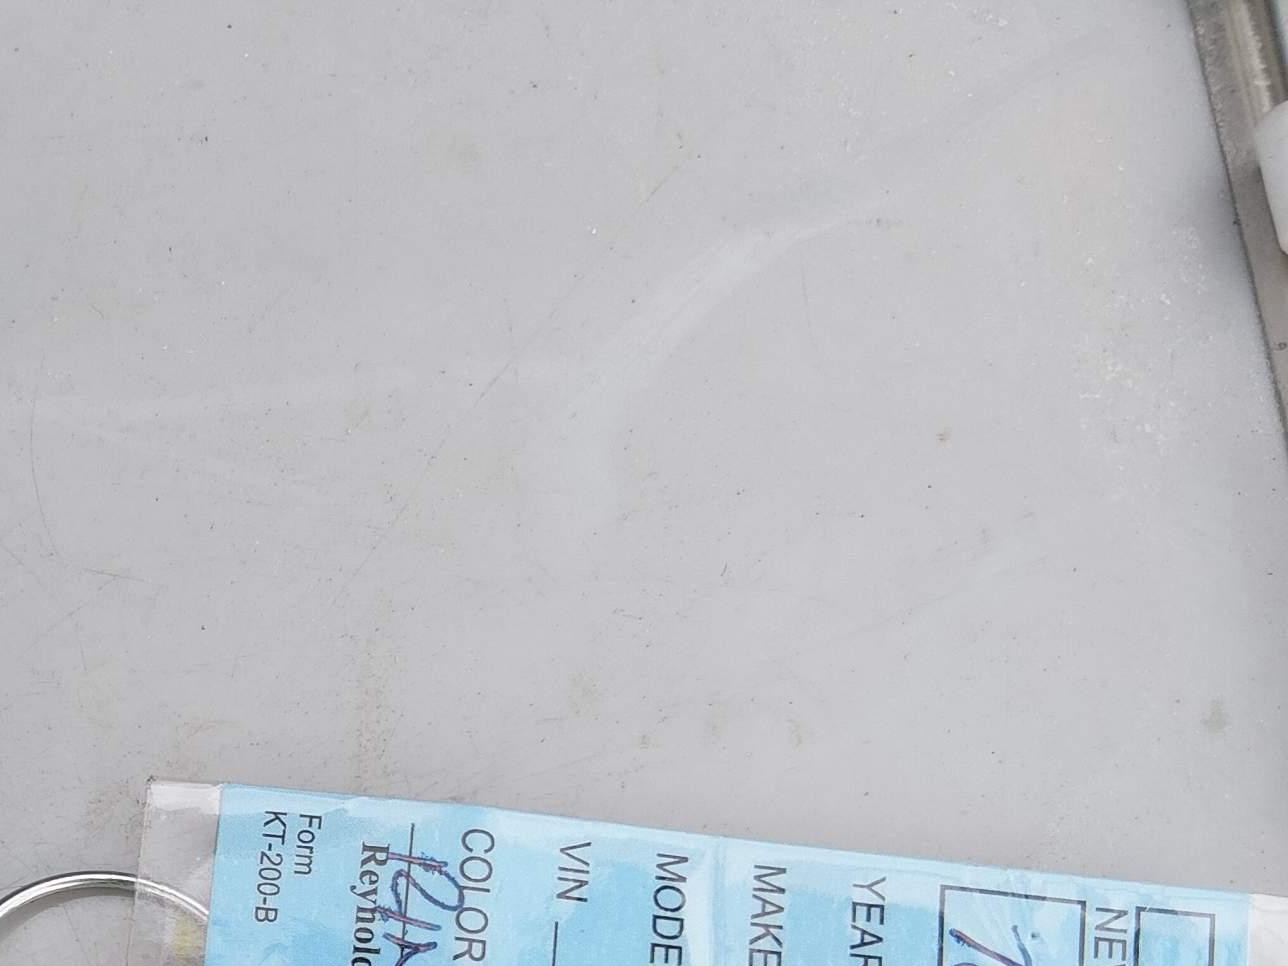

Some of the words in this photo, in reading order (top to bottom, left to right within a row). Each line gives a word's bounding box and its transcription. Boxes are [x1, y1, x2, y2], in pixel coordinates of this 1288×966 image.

[254, 810, 288, 923] KT-200-B
[293, 812, 323, 876] Form
[555, 841, 593, 904] VIN
[452, 828, 495, 962] COLOR
